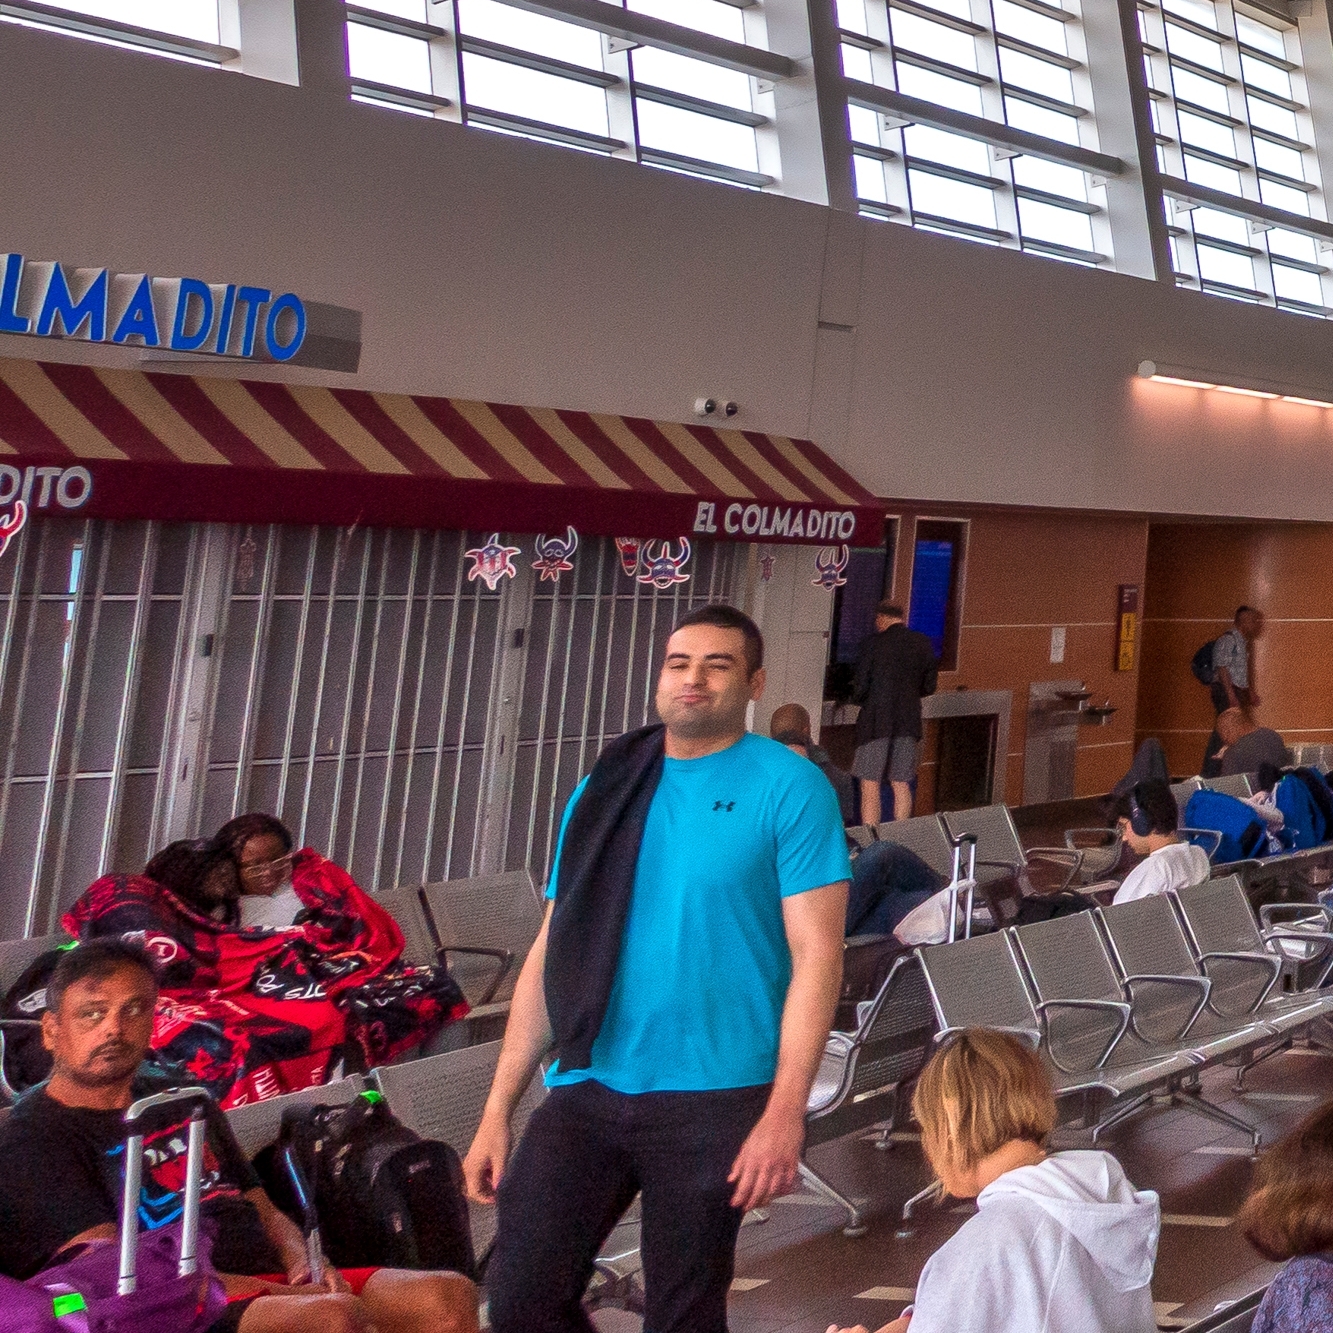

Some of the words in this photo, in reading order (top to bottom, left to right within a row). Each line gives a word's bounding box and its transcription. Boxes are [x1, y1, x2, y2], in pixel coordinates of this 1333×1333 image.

[0, 253, 306, 361] LMADITO
[693, 501, 718, 533] EL
[724, 502, 856, 540] COLMADITO
